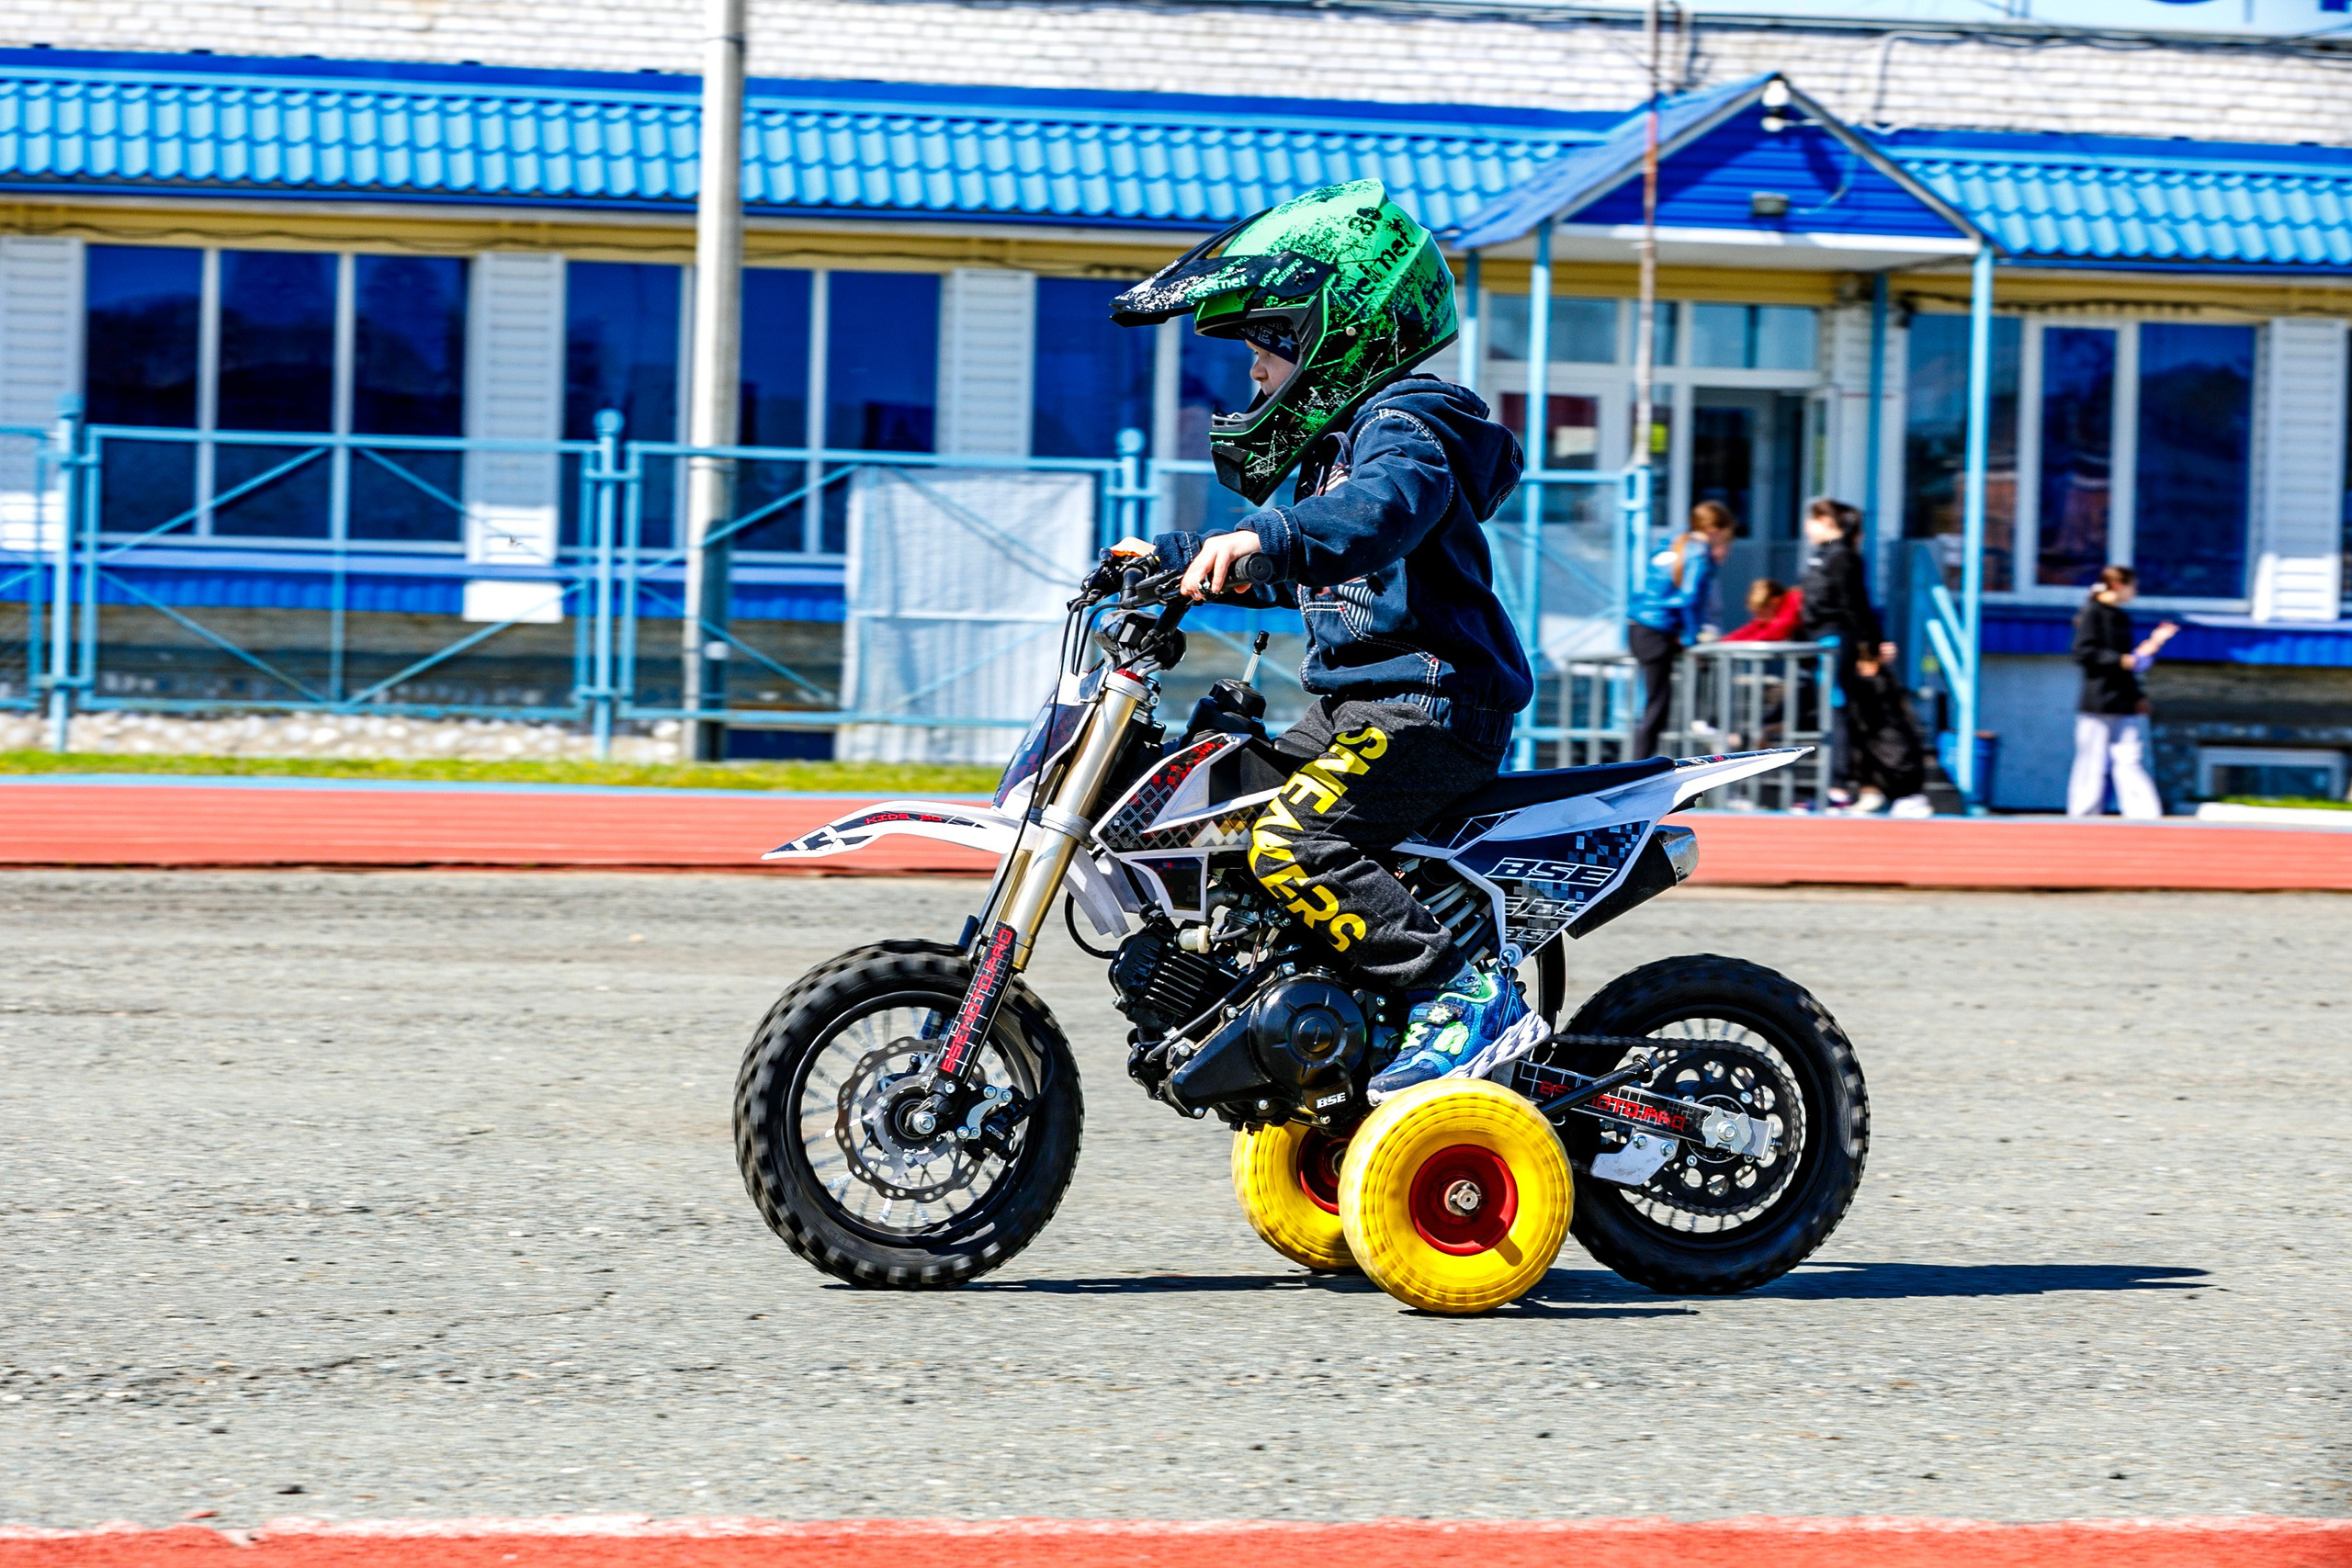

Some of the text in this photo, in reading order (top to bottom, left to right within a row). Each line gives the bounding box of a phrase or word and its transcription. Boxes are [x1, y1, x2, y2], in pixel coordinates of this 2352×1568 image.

[865, 812, 910, 825] KIDS
[1249, 727, 1387, 952] SNEAKERS
[1483, 857, 1617, 886] BSE
[941, 928, 1013, 1073] BSEMOTO.PRO
[1316, 1091, 1346, 1109] BSE
